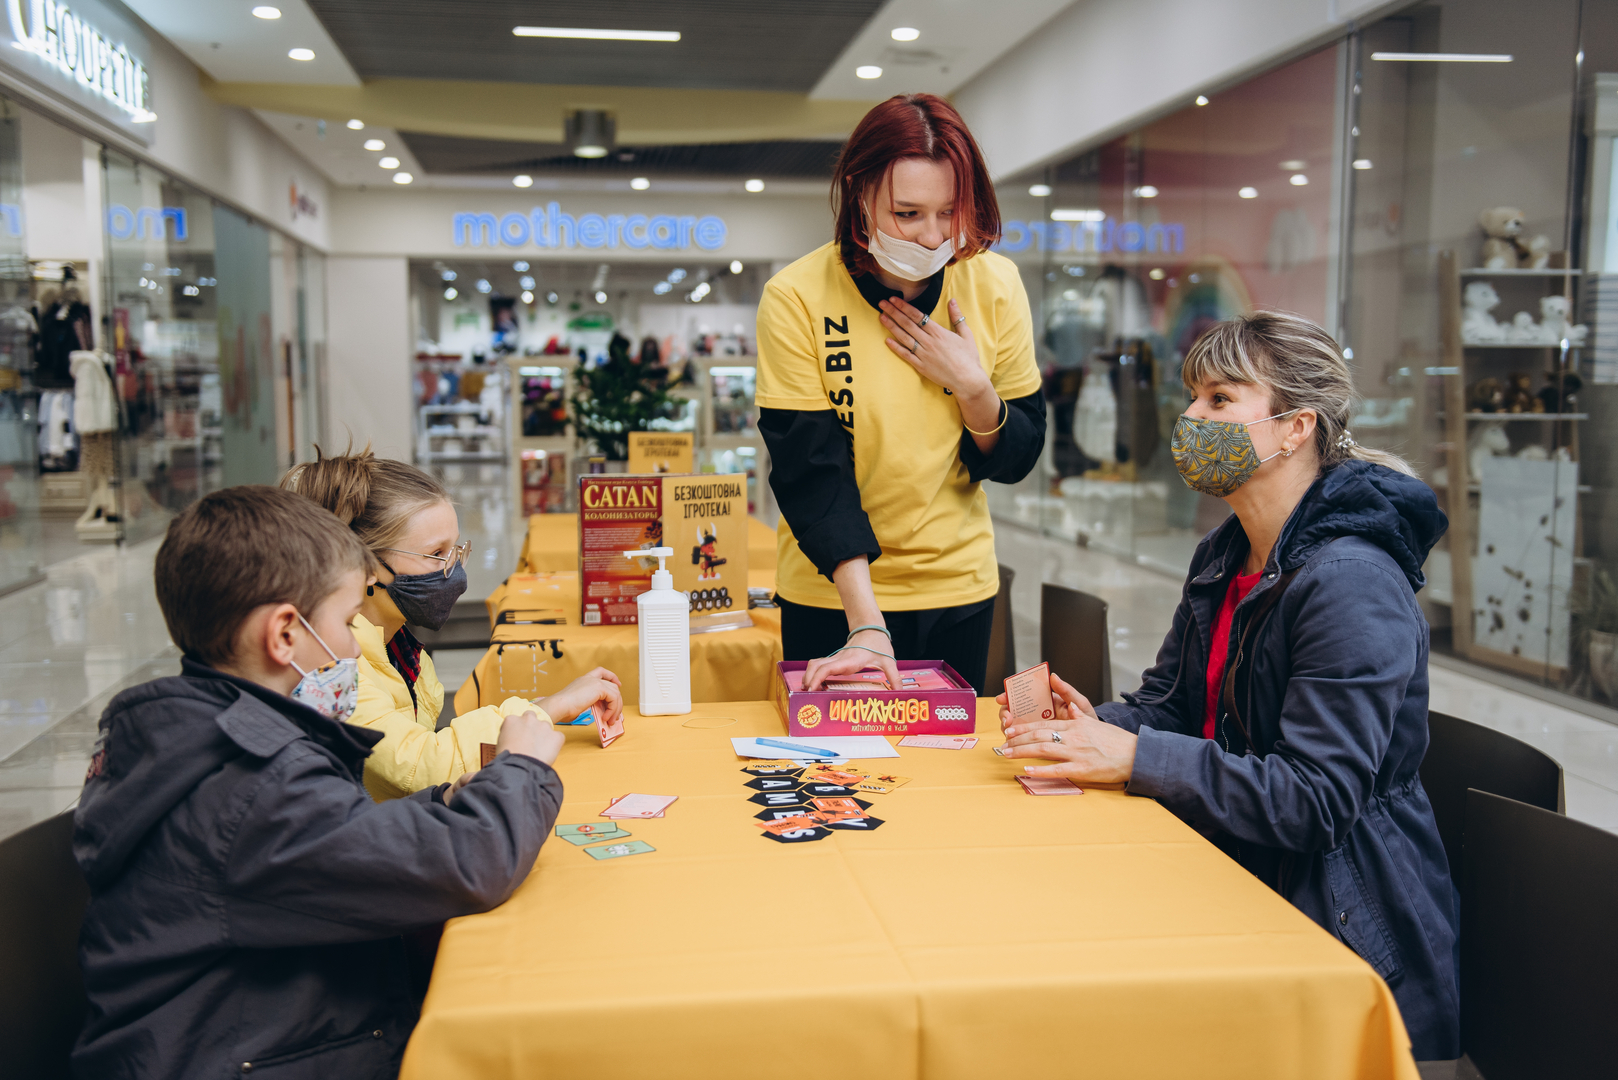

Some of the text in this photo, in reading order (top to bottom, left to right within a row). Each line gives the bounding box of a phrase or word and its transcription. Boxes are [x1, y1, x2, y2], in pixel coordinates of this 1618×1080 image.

[453, 201, 726, 249] mothercare
[824, 315, 855, 445] ES.BIZ
[584, 485, 658, 508] CATAN
[674, 483, 742, 501] БЕЗКОШТОВНА
[585, 511, 658, 520] КОЛОНИЗАТОРЫ
[683, 501, 731, 519] ІГРОТЕКА!
[851, 724, 885, 732] АССОЦИАЦИИ
